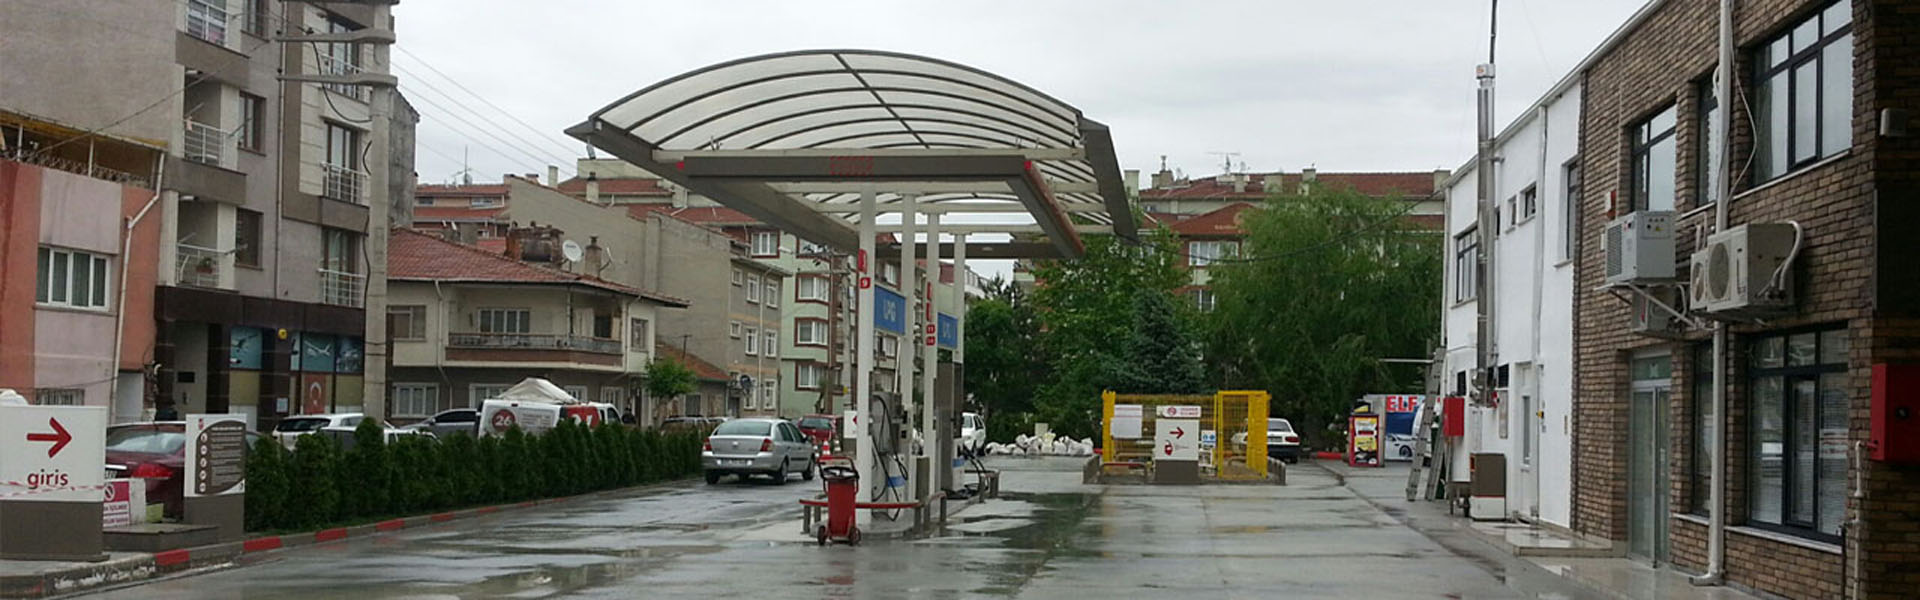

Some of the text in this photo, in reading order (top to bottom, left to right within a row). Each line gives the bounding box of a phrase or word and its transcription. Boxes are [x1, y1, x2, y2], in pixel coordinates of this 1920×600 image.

[861, 279, 868, 288] 9
[883, 300, 896, 322] LPG
[1386, 395, 1418, 413] ELF
[495, 415, 512, 426] 26
[27, 468, 69, 490] giris
